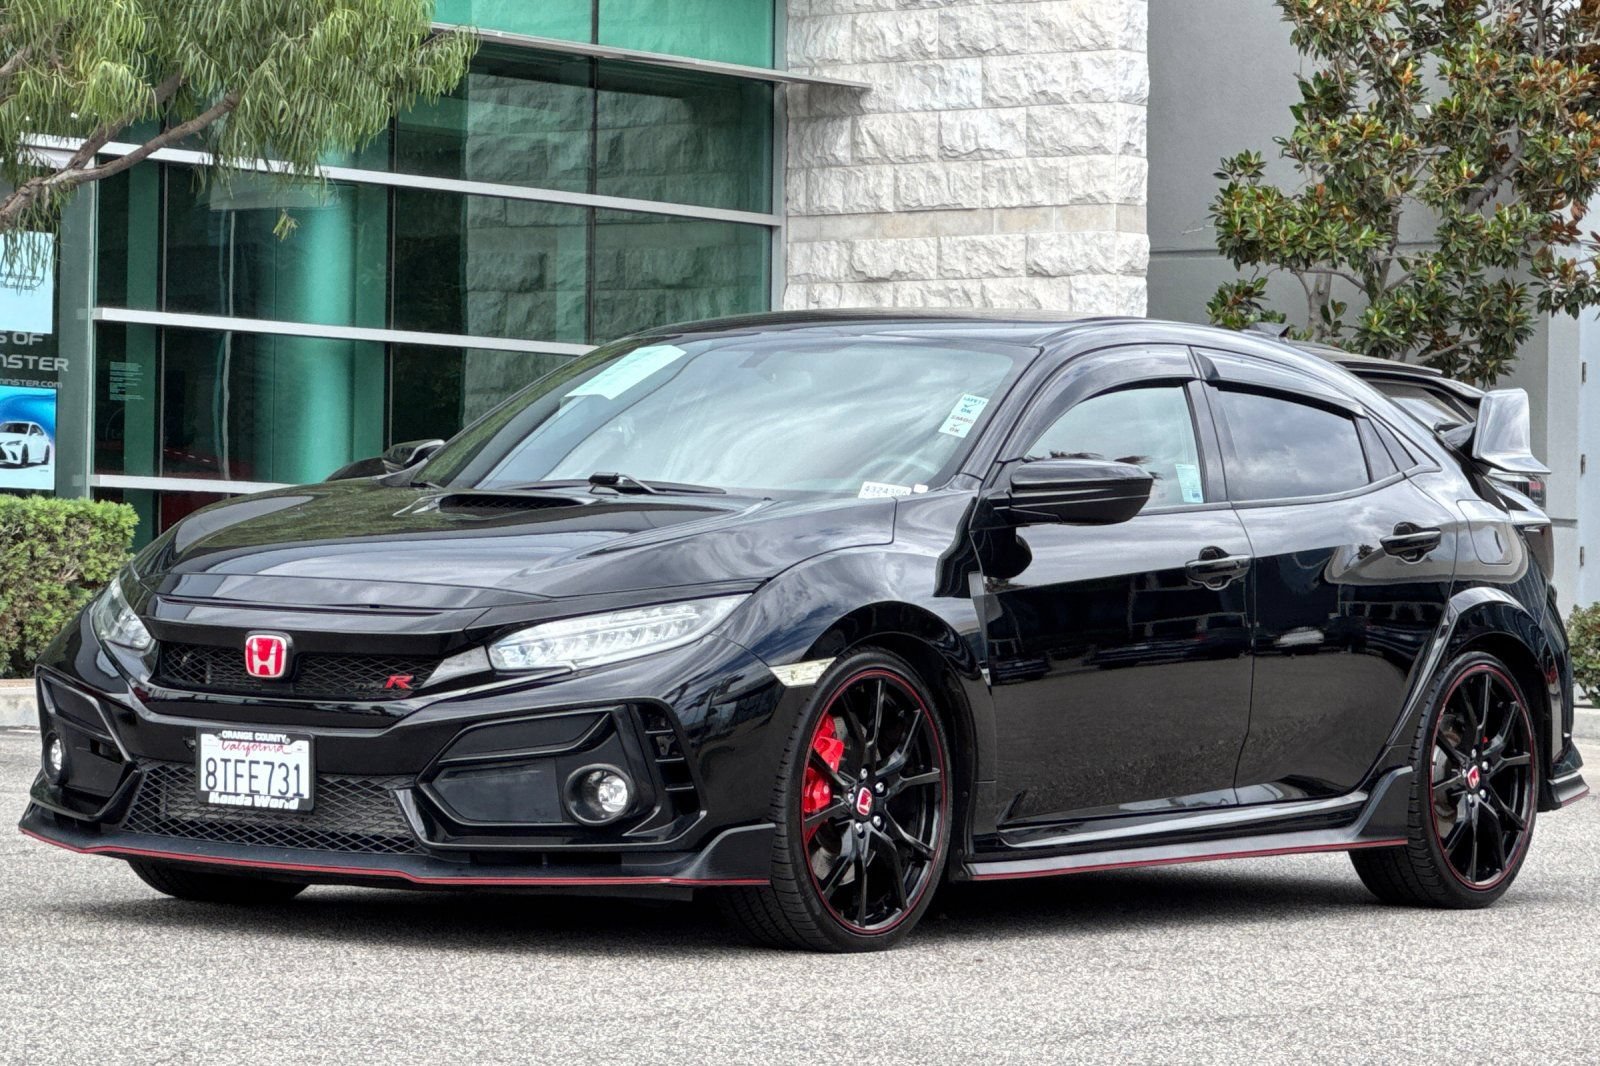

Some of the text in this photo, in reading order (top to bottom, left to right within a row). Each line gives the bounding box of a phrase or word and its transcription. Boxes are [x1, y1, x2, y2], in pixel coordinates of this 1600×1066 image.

[12, 332, 43, 345] OF
[384, 675, 414, 689] R
[221, 730, 287, 744] ORANGE COUNTY
[221, 740, 292, 757] California
[205, 757, 304, 798] 8TFE731
[208, 791, 300, 810] Honda World
